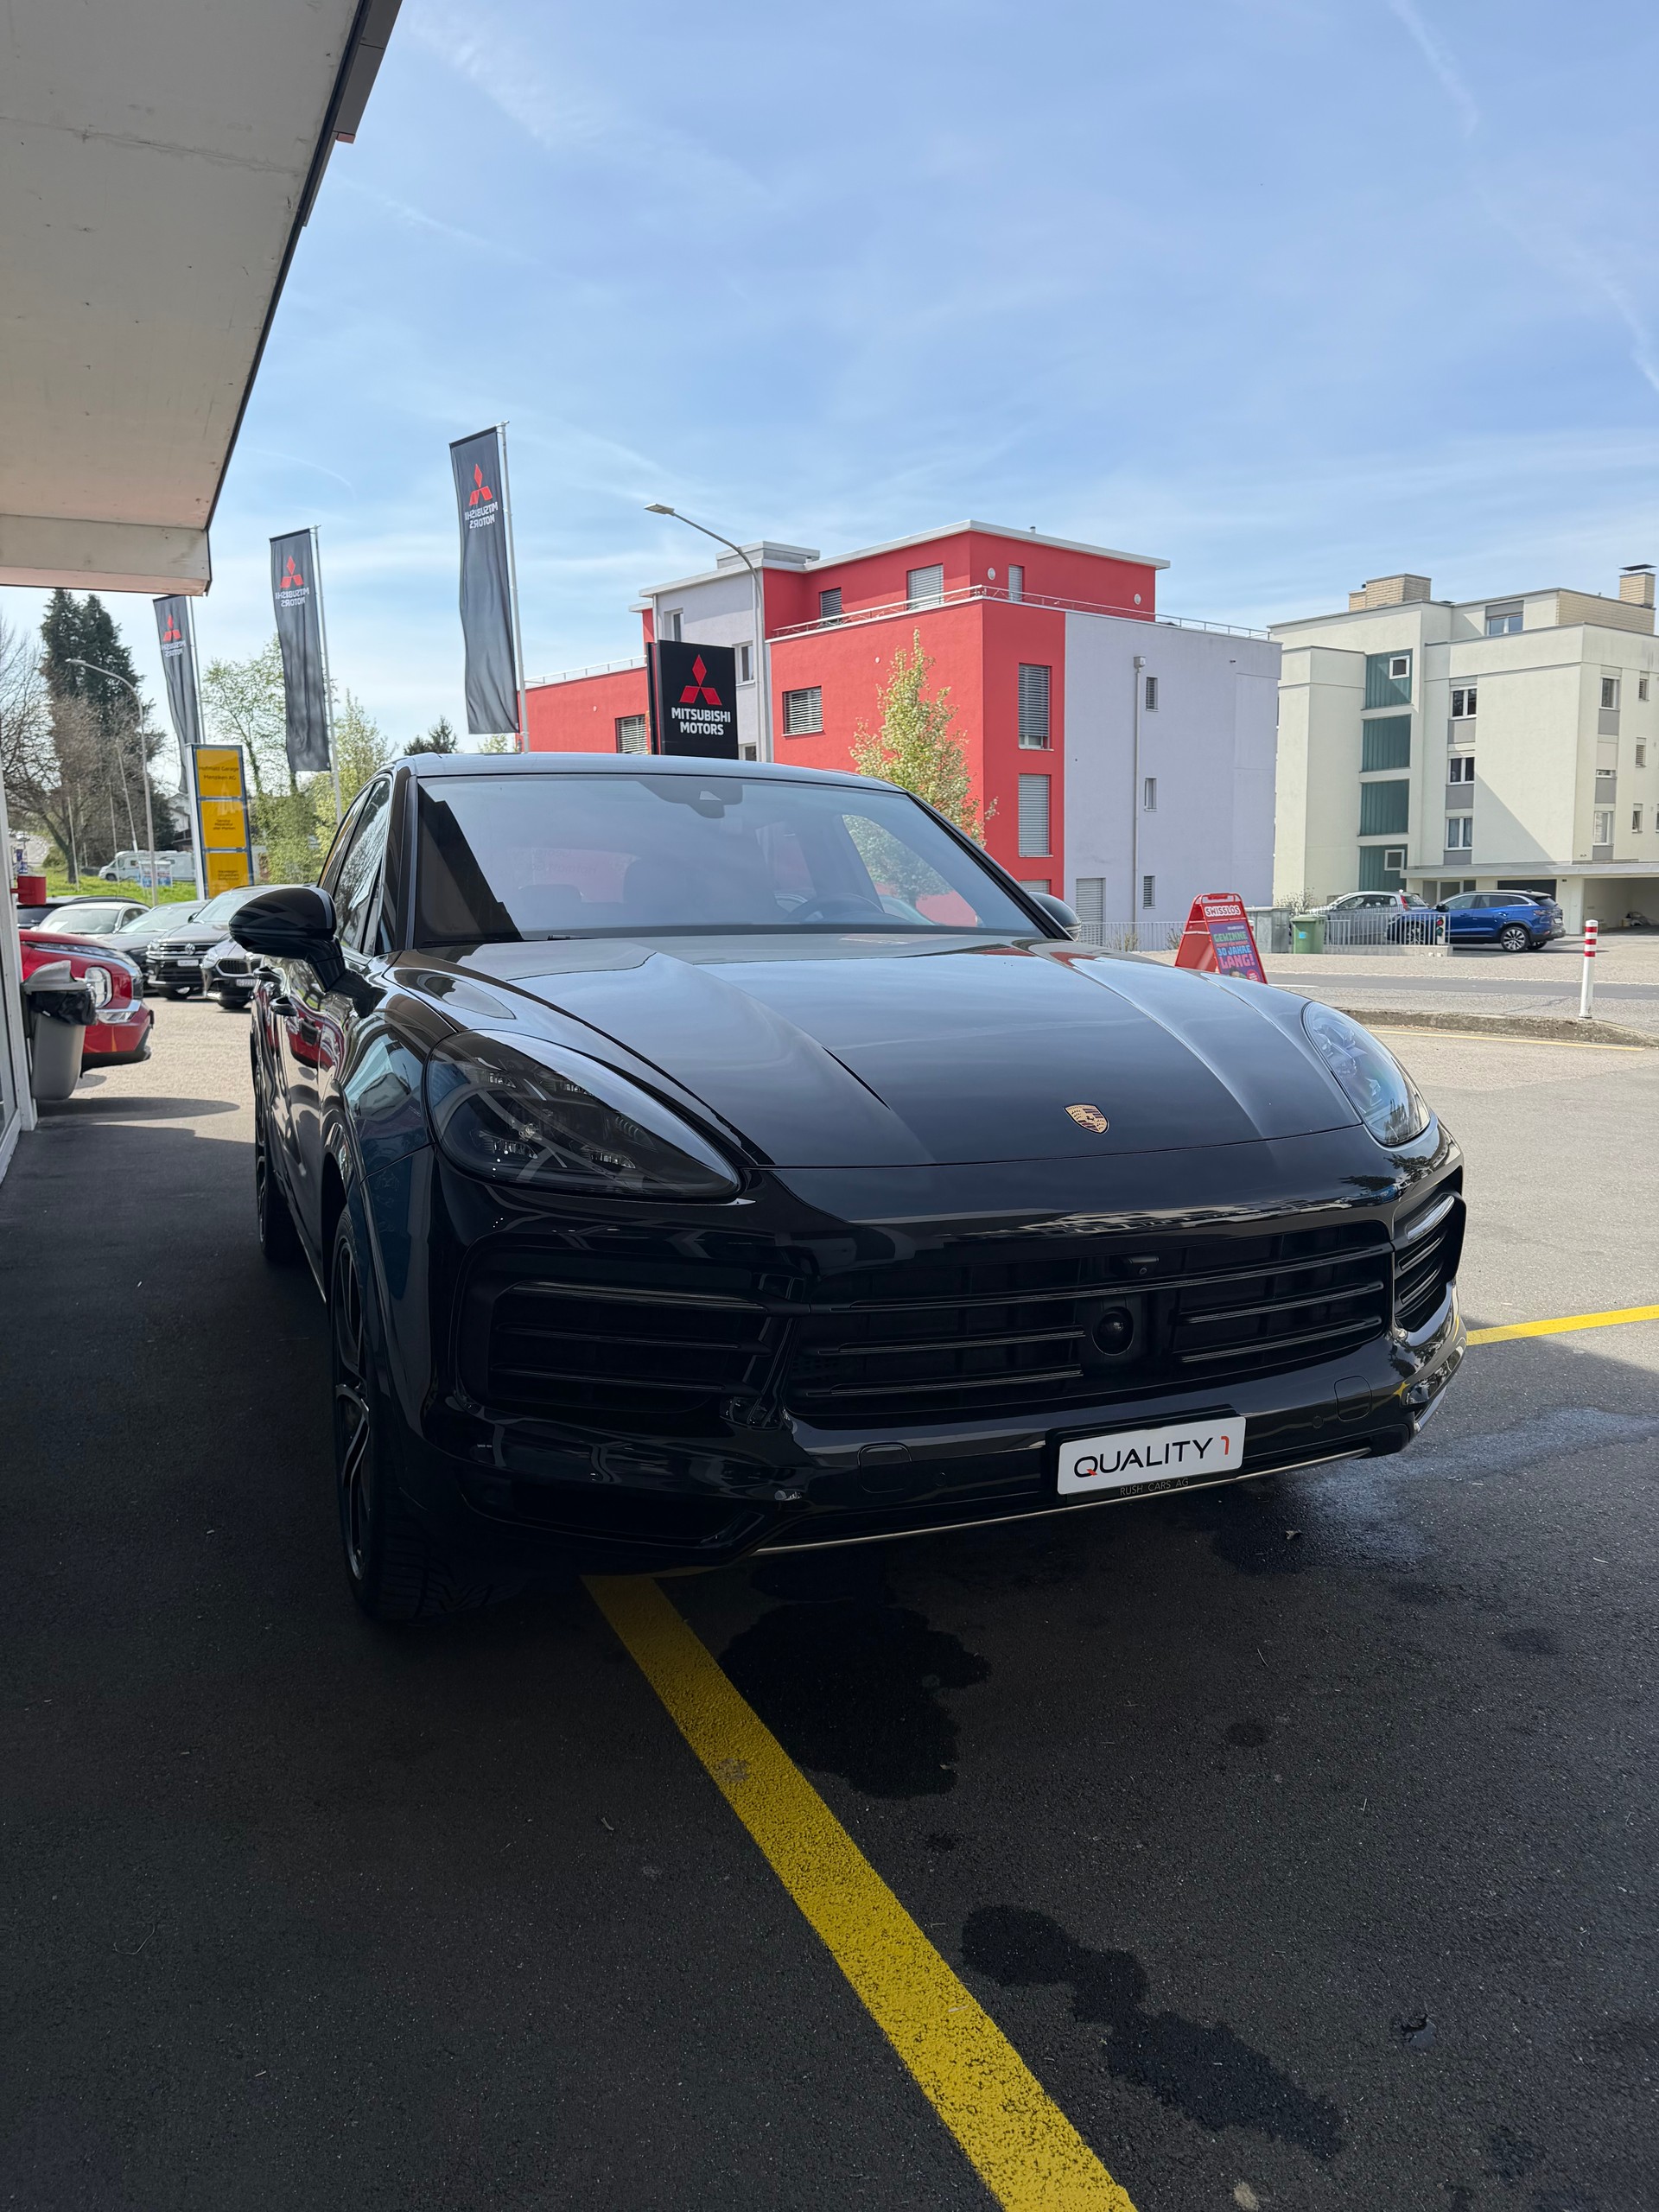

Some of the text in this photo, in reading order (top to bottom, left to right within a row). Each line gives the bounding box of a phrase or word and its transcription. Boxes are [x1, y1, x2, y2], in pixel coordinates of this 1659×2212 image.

[671, 707, 731, 722] MITSUBISHI
[679, 721, 724, 735] MOTORS
[1205, 906, 1240, 916] SWISSLOS
[1213, 931, 1248, 943] GEWINNE
[1217, 944, 1252, 956] 30 JAHRE
[1219, 953, 1255, 969] LANG!
[1073, 1437, 1213, 1478] QUALITY
[1120, 1478, 1189, 1497] RUSH CARS AG
